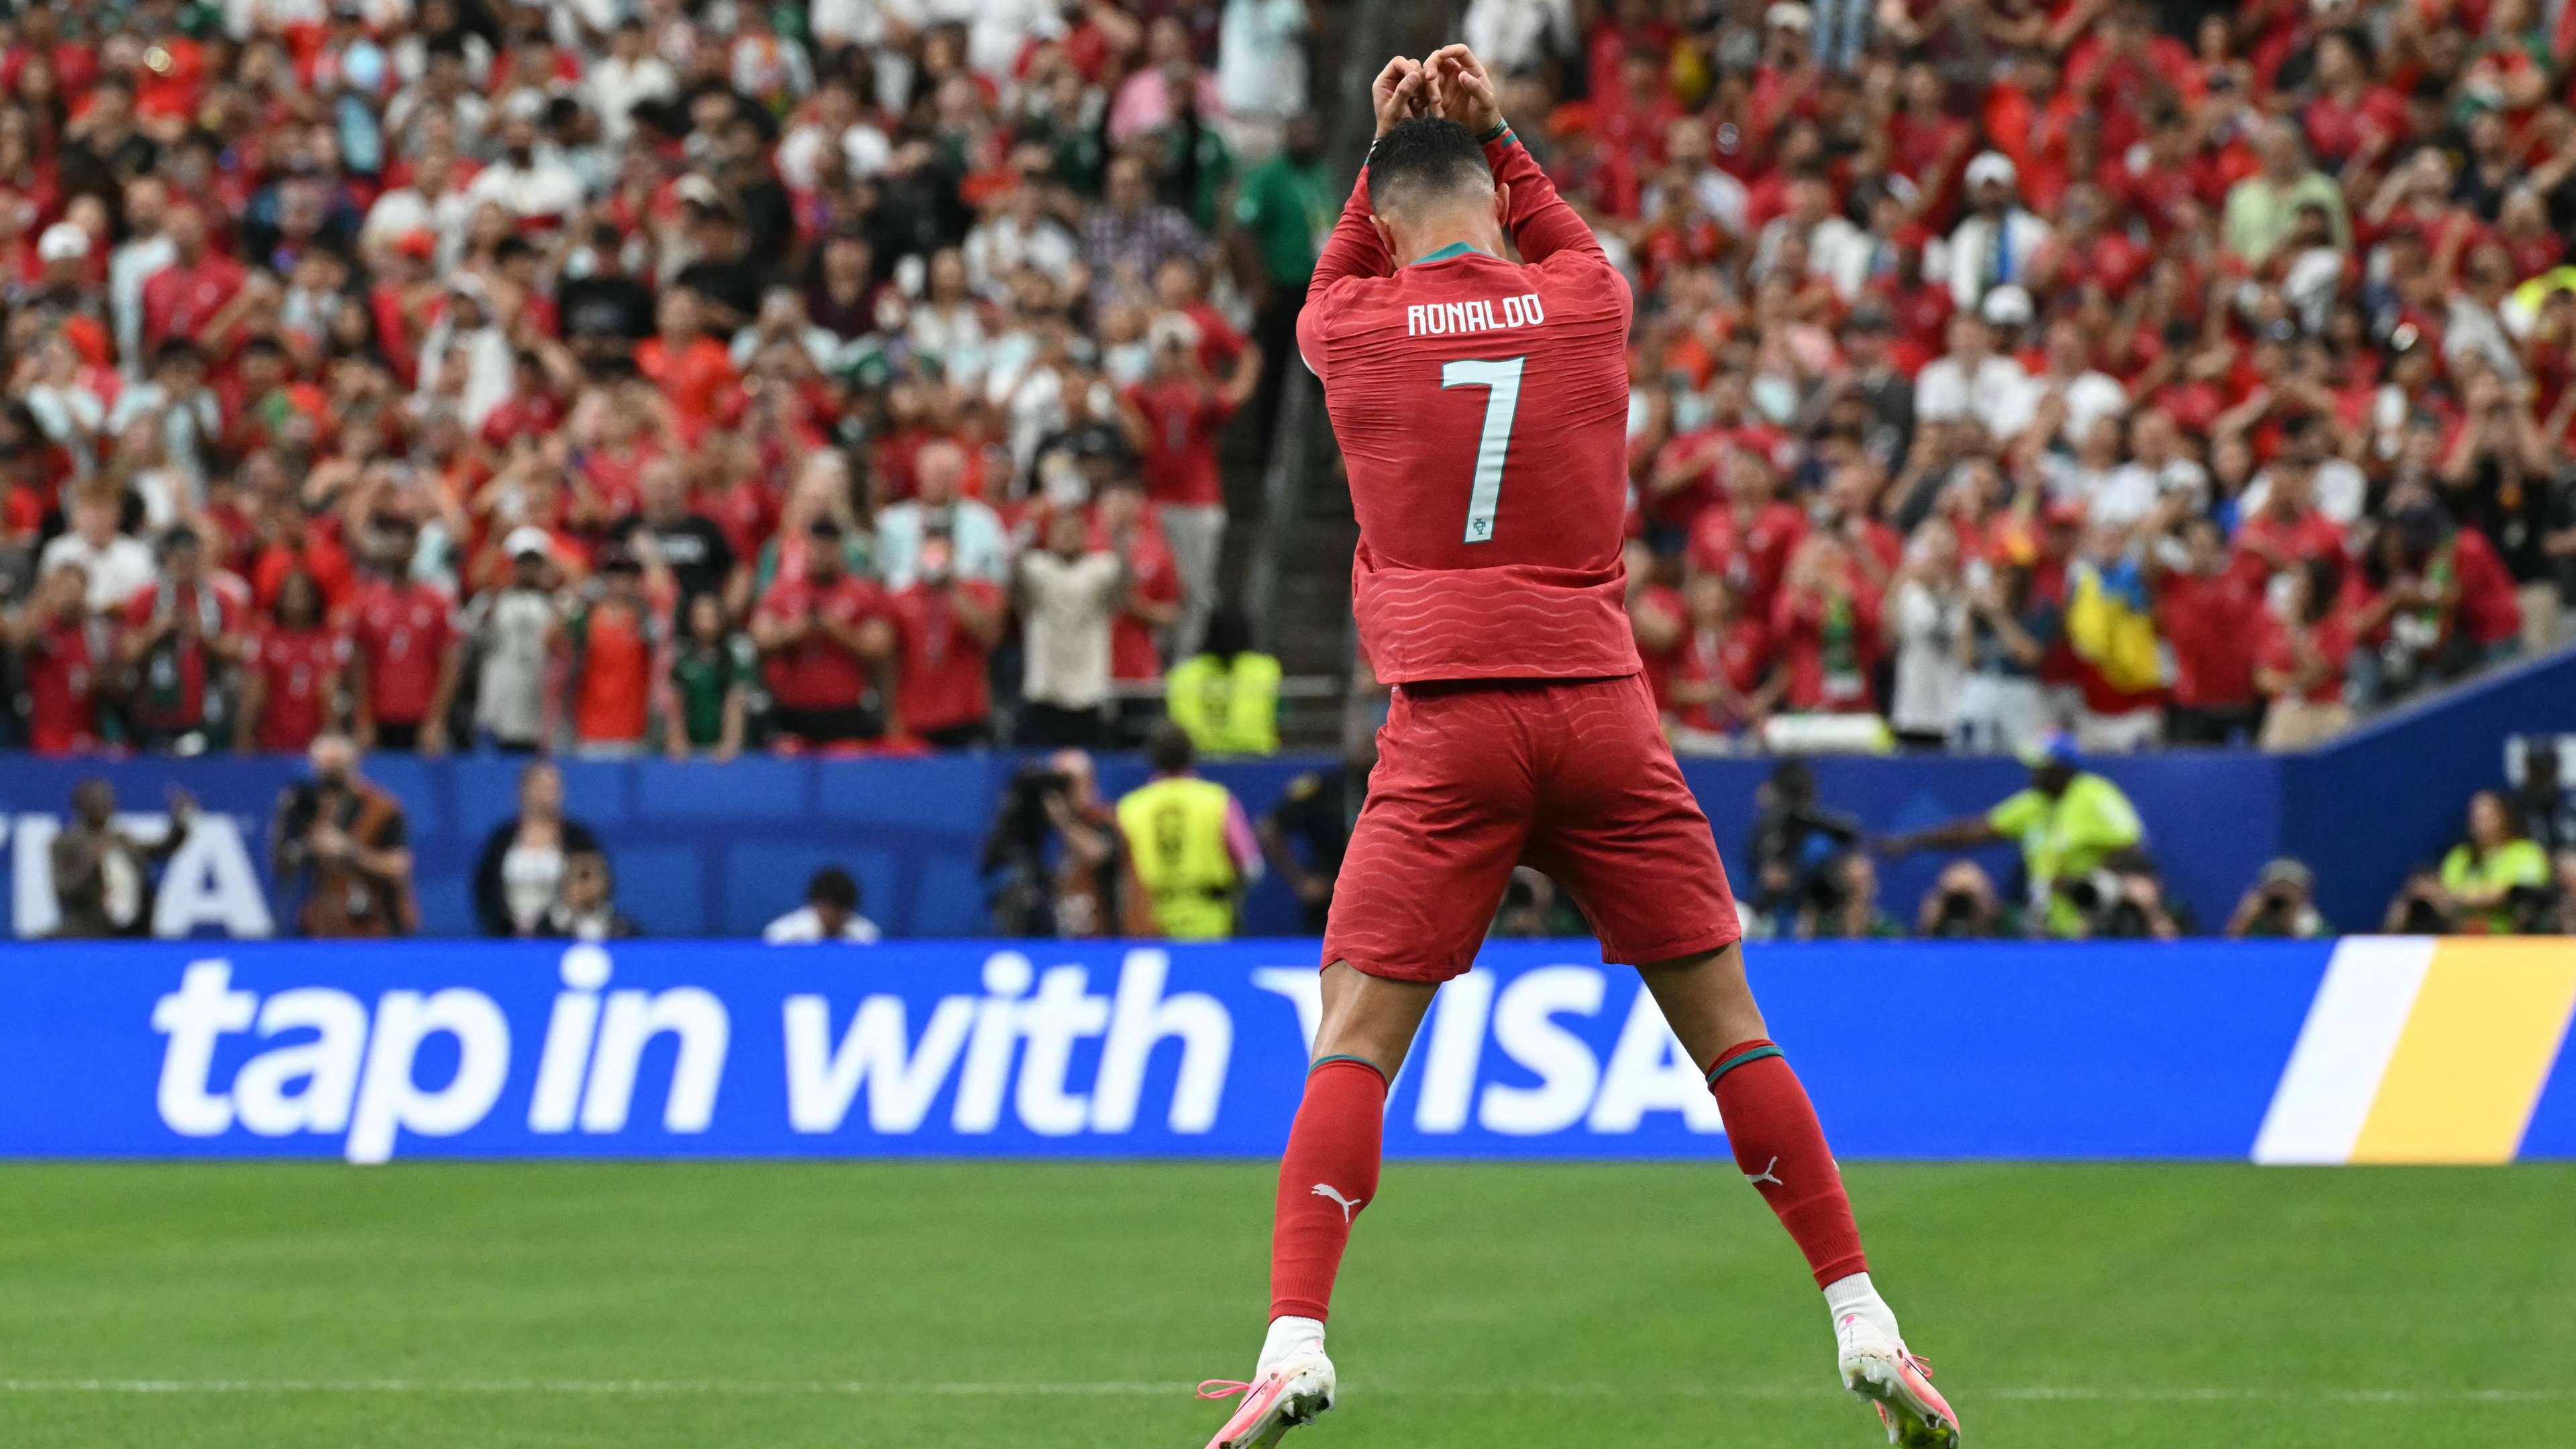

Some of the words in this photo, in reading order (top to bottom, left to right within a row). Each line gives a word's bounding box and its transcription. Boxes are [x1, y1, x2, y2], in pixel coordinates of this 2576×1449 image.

[1407, 292, 1544, 336] RONALDO
[1441, 356, 1526, 545] 7
[152, 959, 511, 1163] tap
[527, 941, 730, 1134] in
[782, 949, 1233, 1135] with
